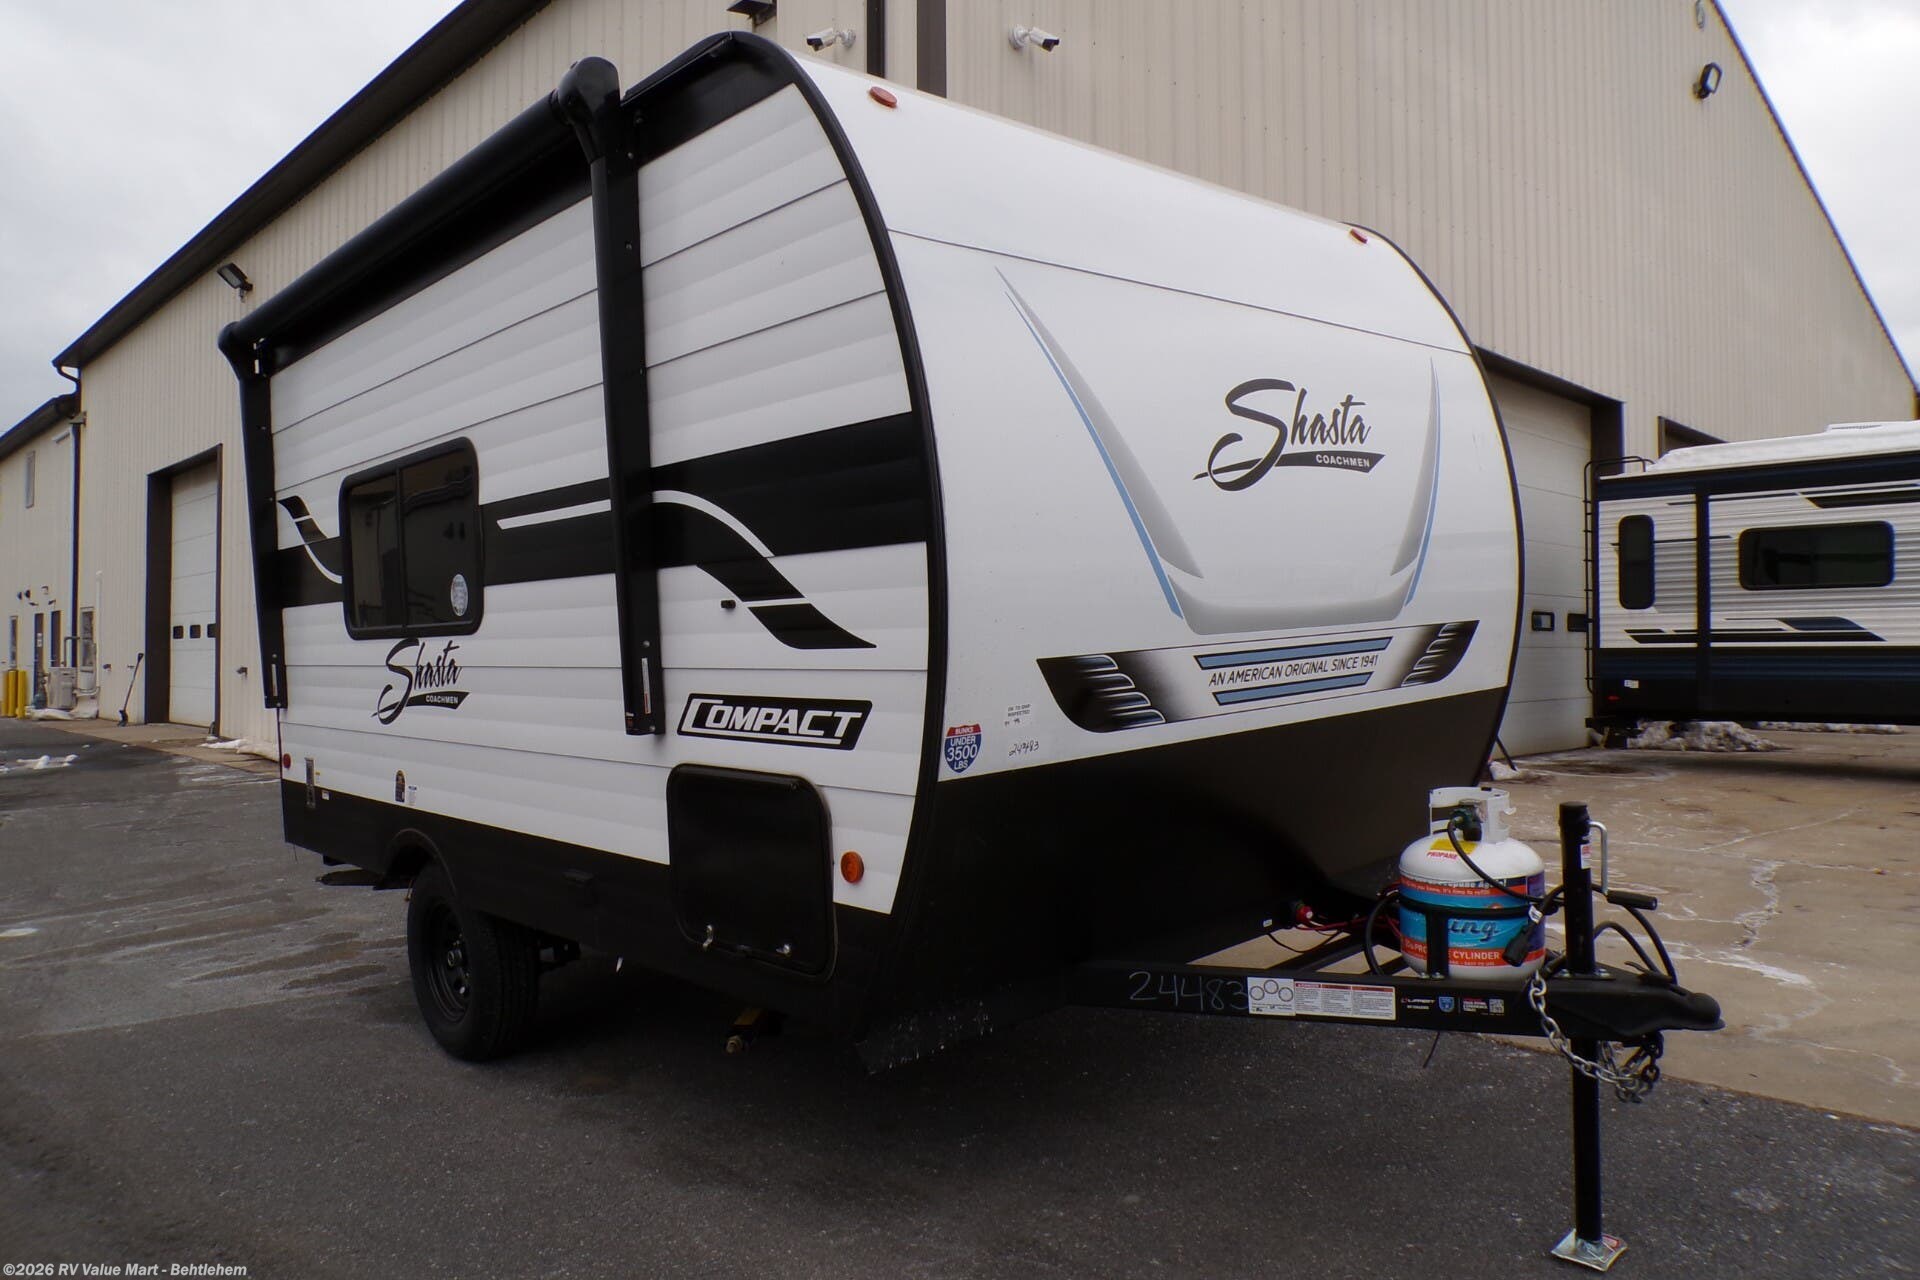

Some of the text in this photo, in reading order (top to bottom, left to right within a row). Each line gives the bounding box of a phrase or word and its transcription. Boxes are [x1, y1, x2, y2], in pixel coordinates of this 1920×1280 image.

[1207, 377, 1372, 492] Shasta
[1315, 453, 1370, 468] COACHMEN
[377, 637, 462, 725] Shasta
[1209, 654, 1379, 687] AN AMERICAN ORIGINAL SINCE 1941
[425, 694, 459, 704] COACHMEN
[681, 698, 863, 745] COMPACT
[950, 735, 976, 747] UNDER
[947, 744, 978, 761] 3500
[953, 760, 969, 770] LBS
[1449, 918, 1500, 943] ing
[1453, 951, 1500, 960] CYLINDER
[1128, 970, 1248, 1012] 24483
